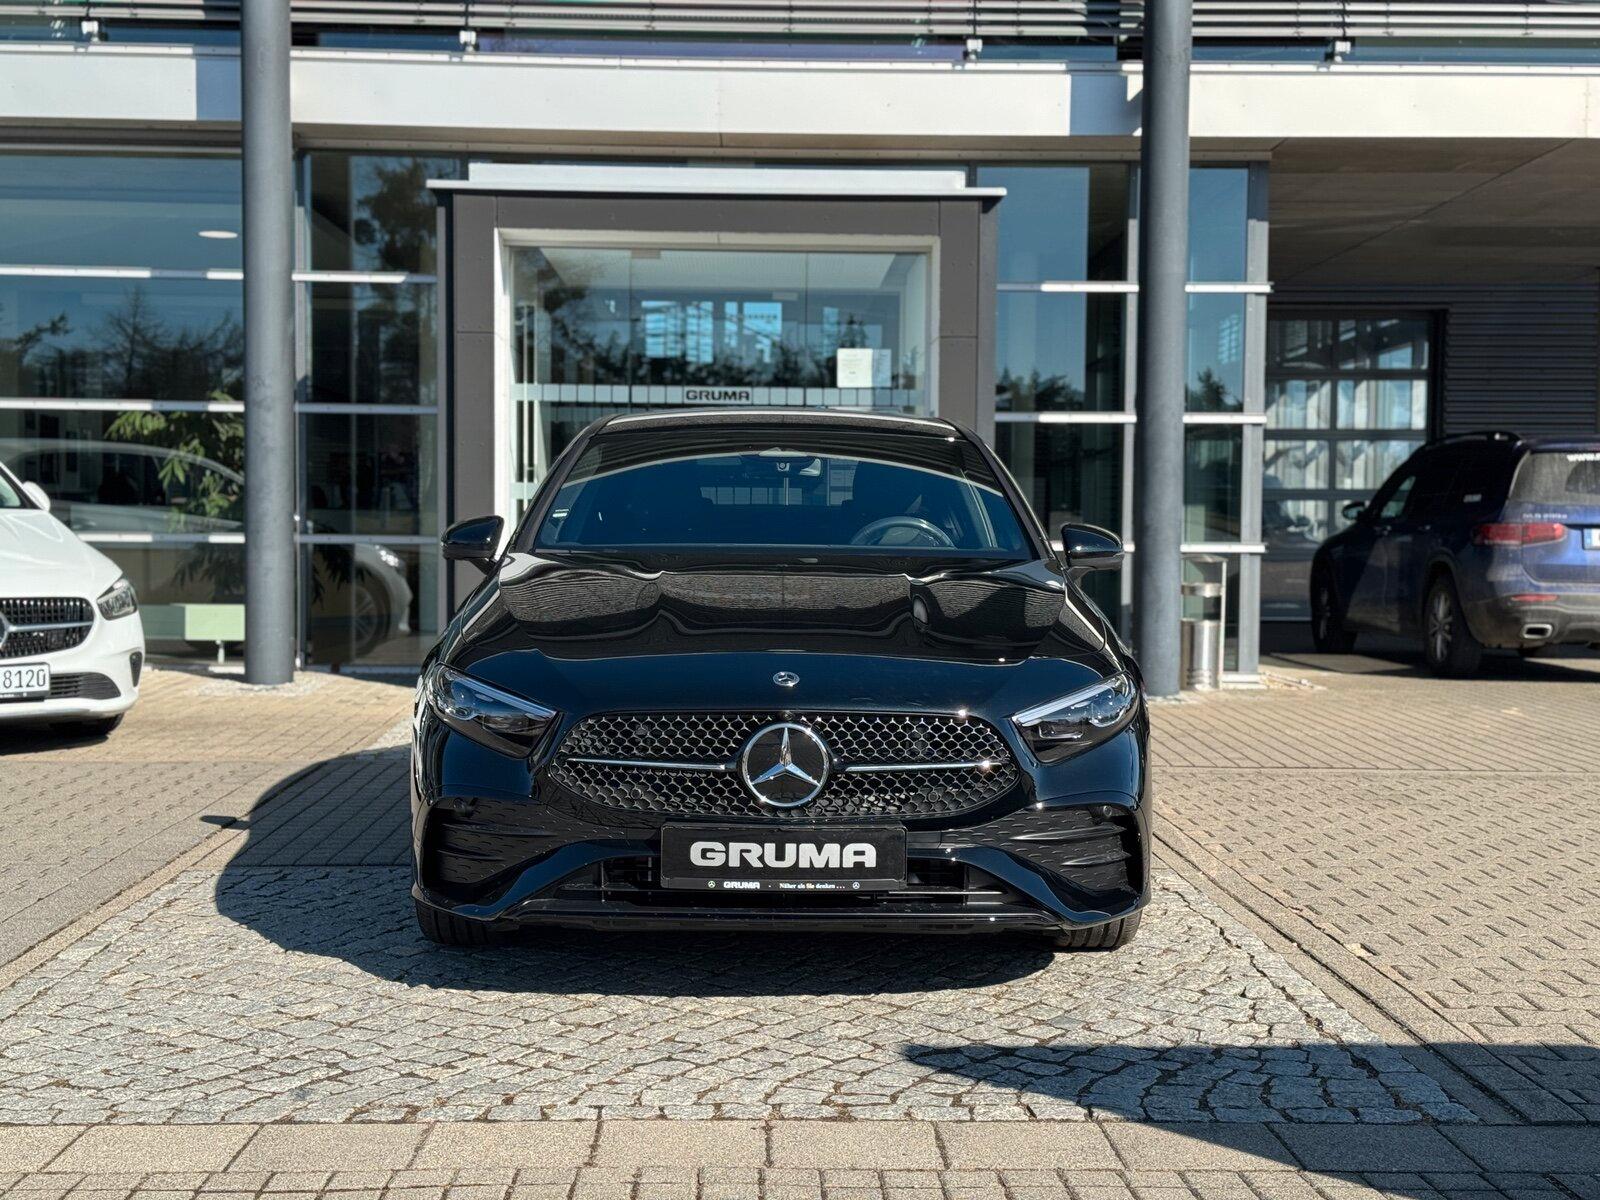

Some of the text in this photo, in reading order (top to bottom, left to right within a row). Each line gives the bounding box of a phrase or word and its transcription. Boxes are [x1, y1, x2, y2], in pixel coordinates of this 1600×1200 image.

[686, 390, 750, 401] GRUMA
[3, 669, 46, 688] 8120
[690, 841, 877, 868] GRUMA
[723, 881, 761, 890] GRUMA
